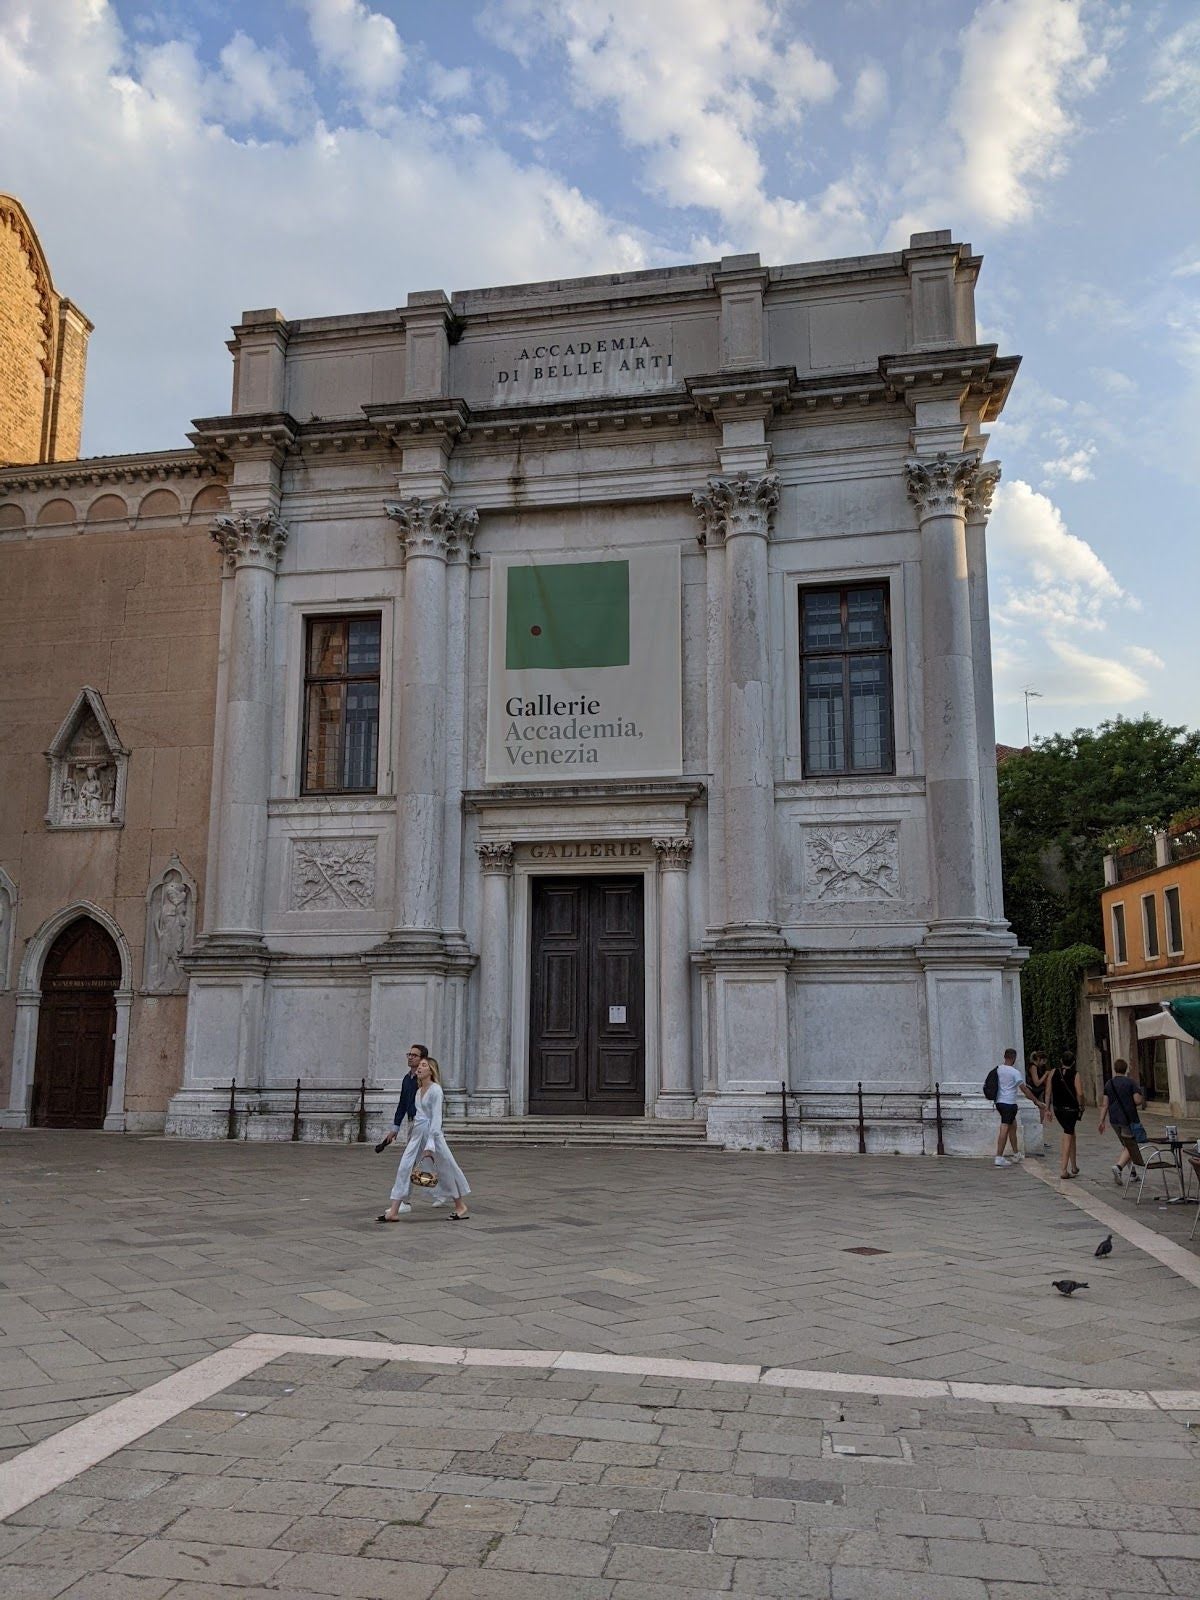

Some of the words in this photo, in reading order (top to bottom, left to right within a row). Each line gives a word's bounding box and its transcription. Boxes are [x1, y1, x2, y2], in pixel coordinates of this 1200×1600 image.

[520, 336, 651, 360] ACCADEMIA
[497, 369, 520, 384] DI
[533, 361, 603, 380] BELLE
[619, 354, 673, 372] ARTI
[505, 694, 601, 717] Gallerie
[504, 716, 644, 742] Accademia,
[504, 743, 599, 766] Venezia
[530, 842, 642, 858] GALLERIE
